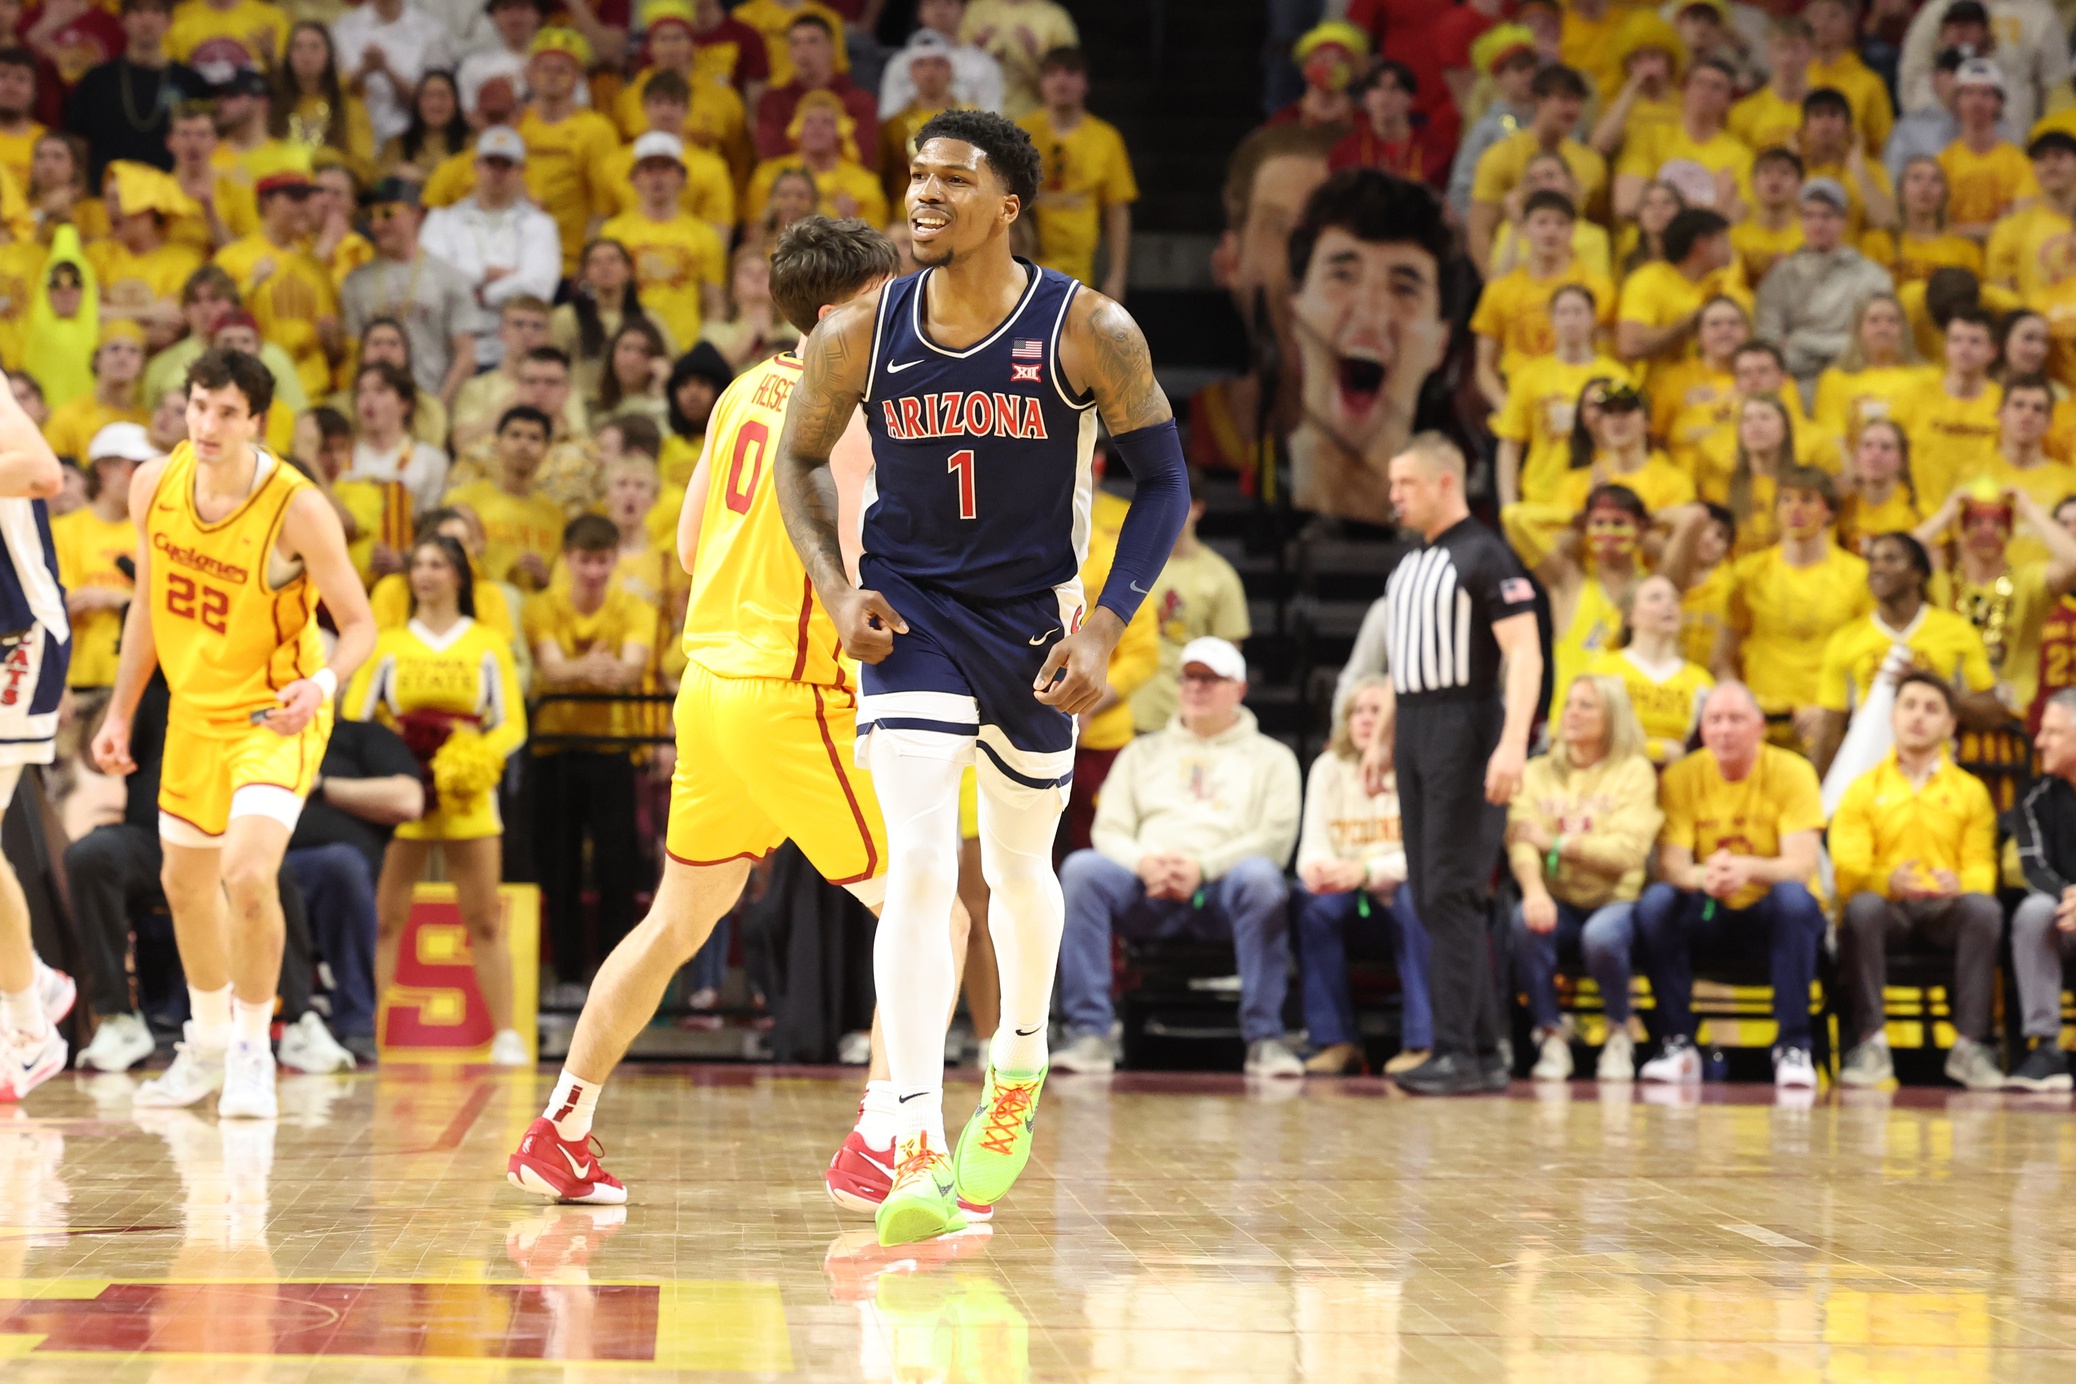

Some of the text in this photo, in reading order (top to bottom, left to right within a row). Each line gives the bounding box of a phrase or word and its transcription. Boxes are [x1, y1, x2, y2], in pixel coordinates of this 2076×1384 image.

[751, 373, 796, 412] HEISE
[1012, 364, 1041, 382] XII
[882, 390, 1048, 440] ARIZONA
[725, 419, 769, 515] 0
[947, 449, 977, 519] 1
[154, 532, 248, 585] Cyclones
[166, 572, 229, 635] 22
[0, 640, 32, 705] ATS
